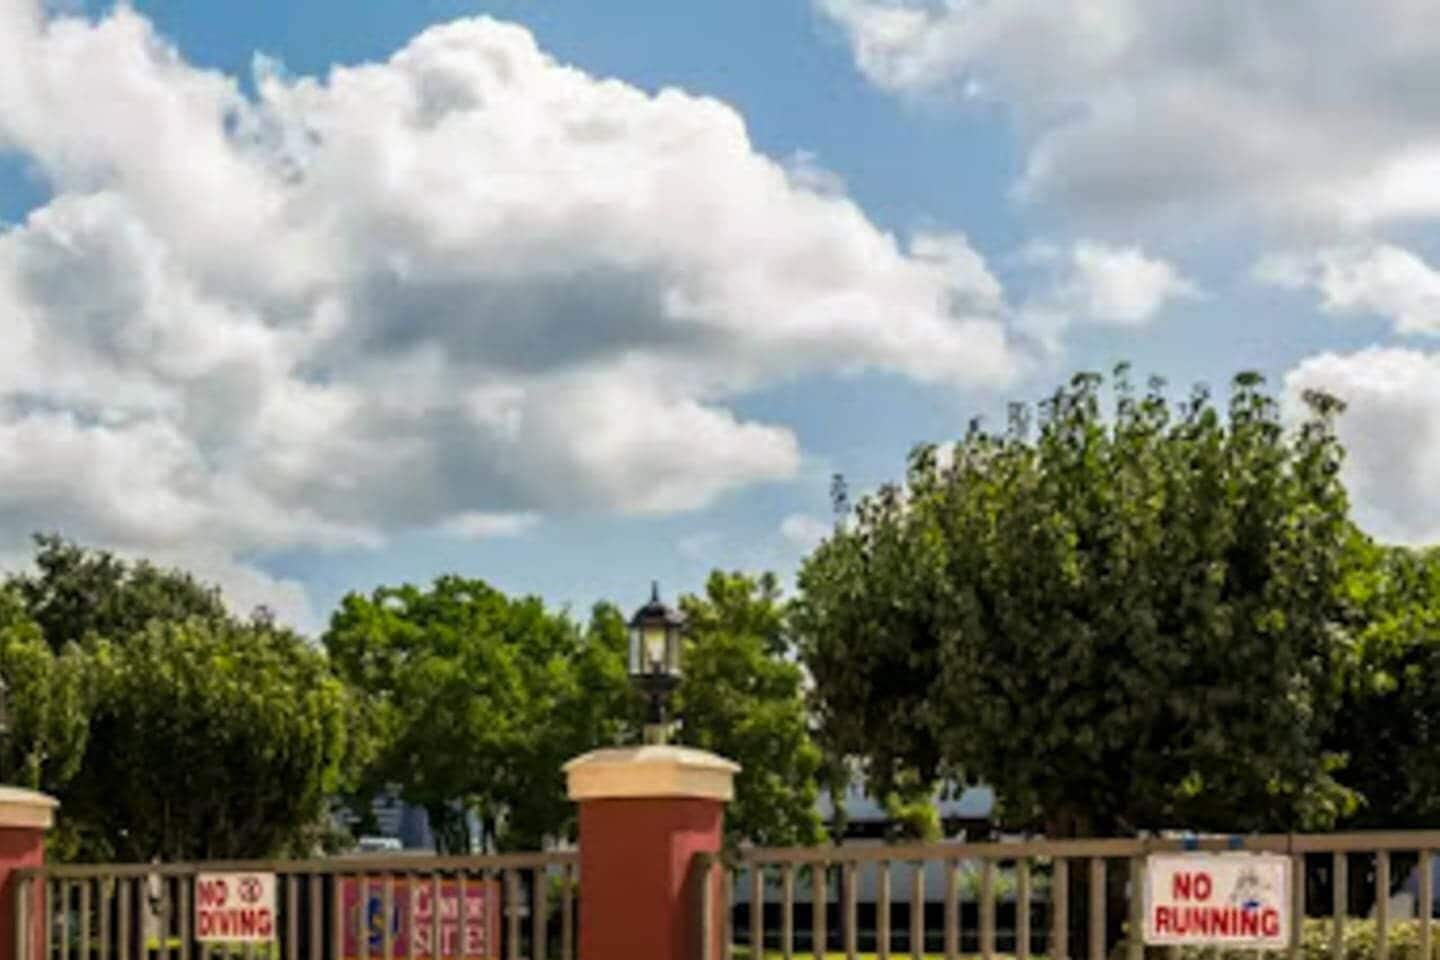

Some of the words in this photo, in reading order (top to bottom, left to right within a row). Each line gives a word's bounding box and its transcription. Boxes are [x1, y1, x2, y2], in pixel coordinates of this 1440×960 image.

[197, 880, 228, 906] NO
[1173, 872, 1213, 900] NO
[198, 908, 273, 936] DIVING
[1155, 905, 1278, 937] RUNNING
